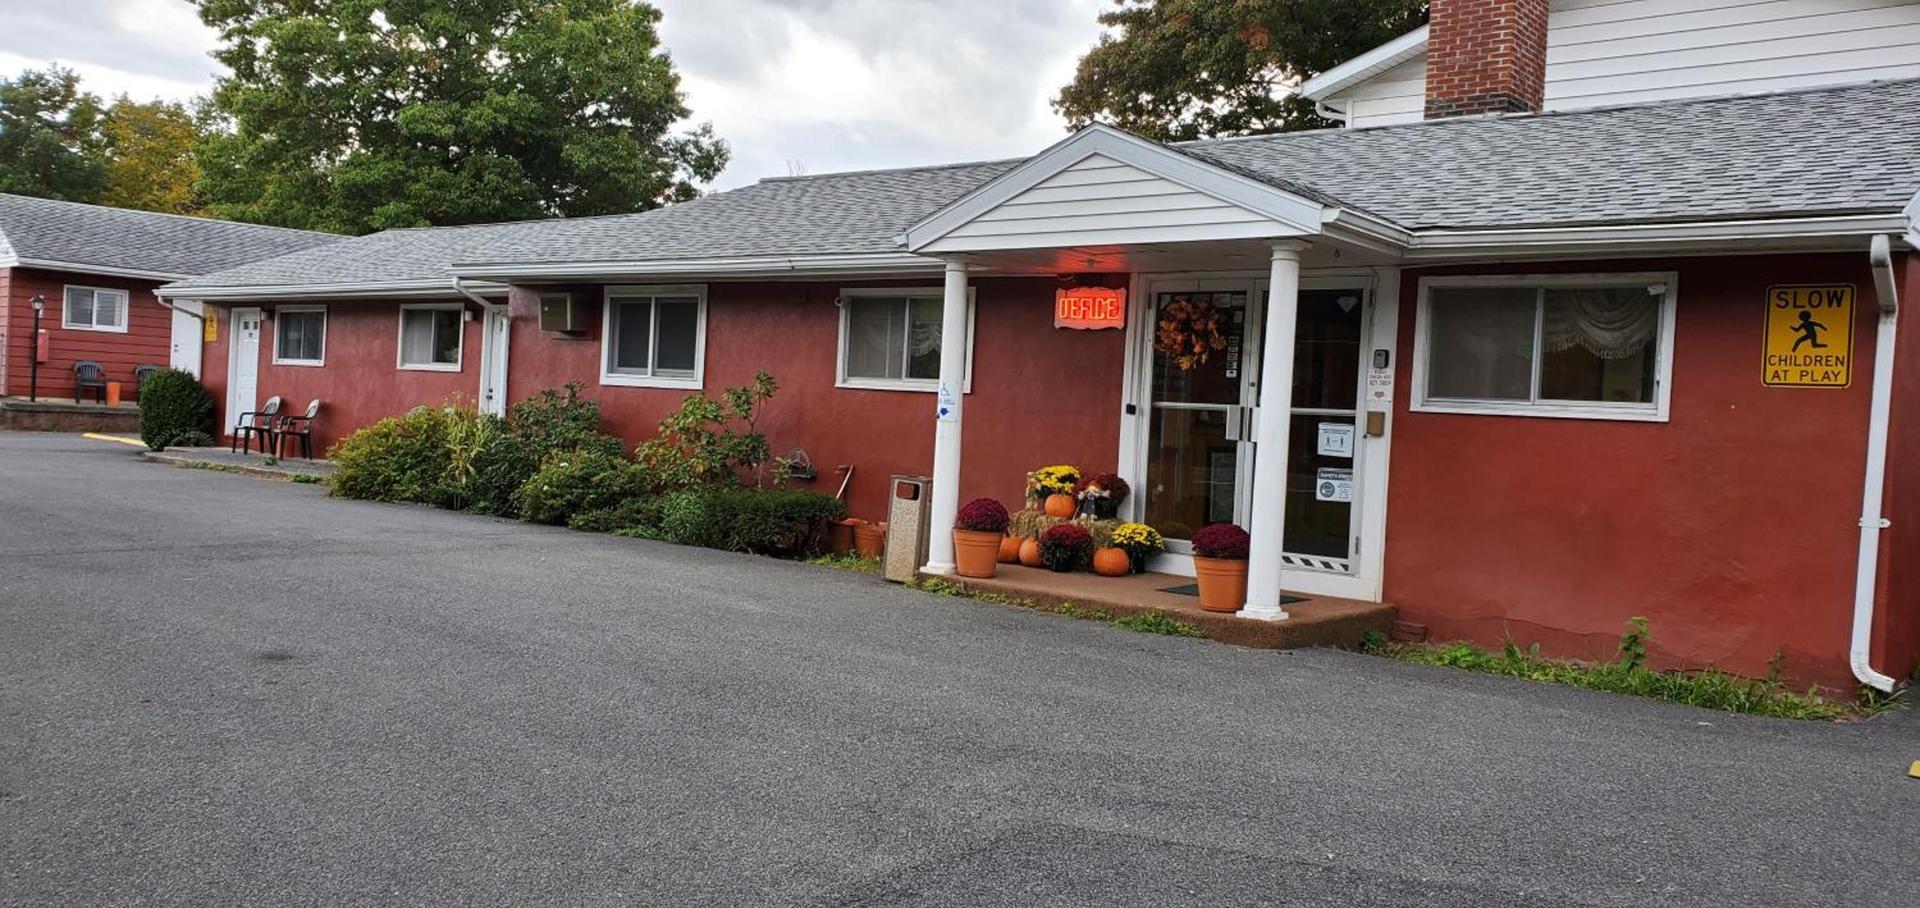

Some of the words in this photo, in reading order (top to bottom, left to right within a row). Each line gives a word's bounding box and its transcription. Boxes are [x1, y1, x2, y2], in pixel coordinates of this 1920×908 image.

[1776, 289, 1845, 309] SLOW
[1768, 354, 1845, 367] CHILDREN
[1771, 369, 1790, 382] AT
[1800, 370, 1842, 382] PLAY
